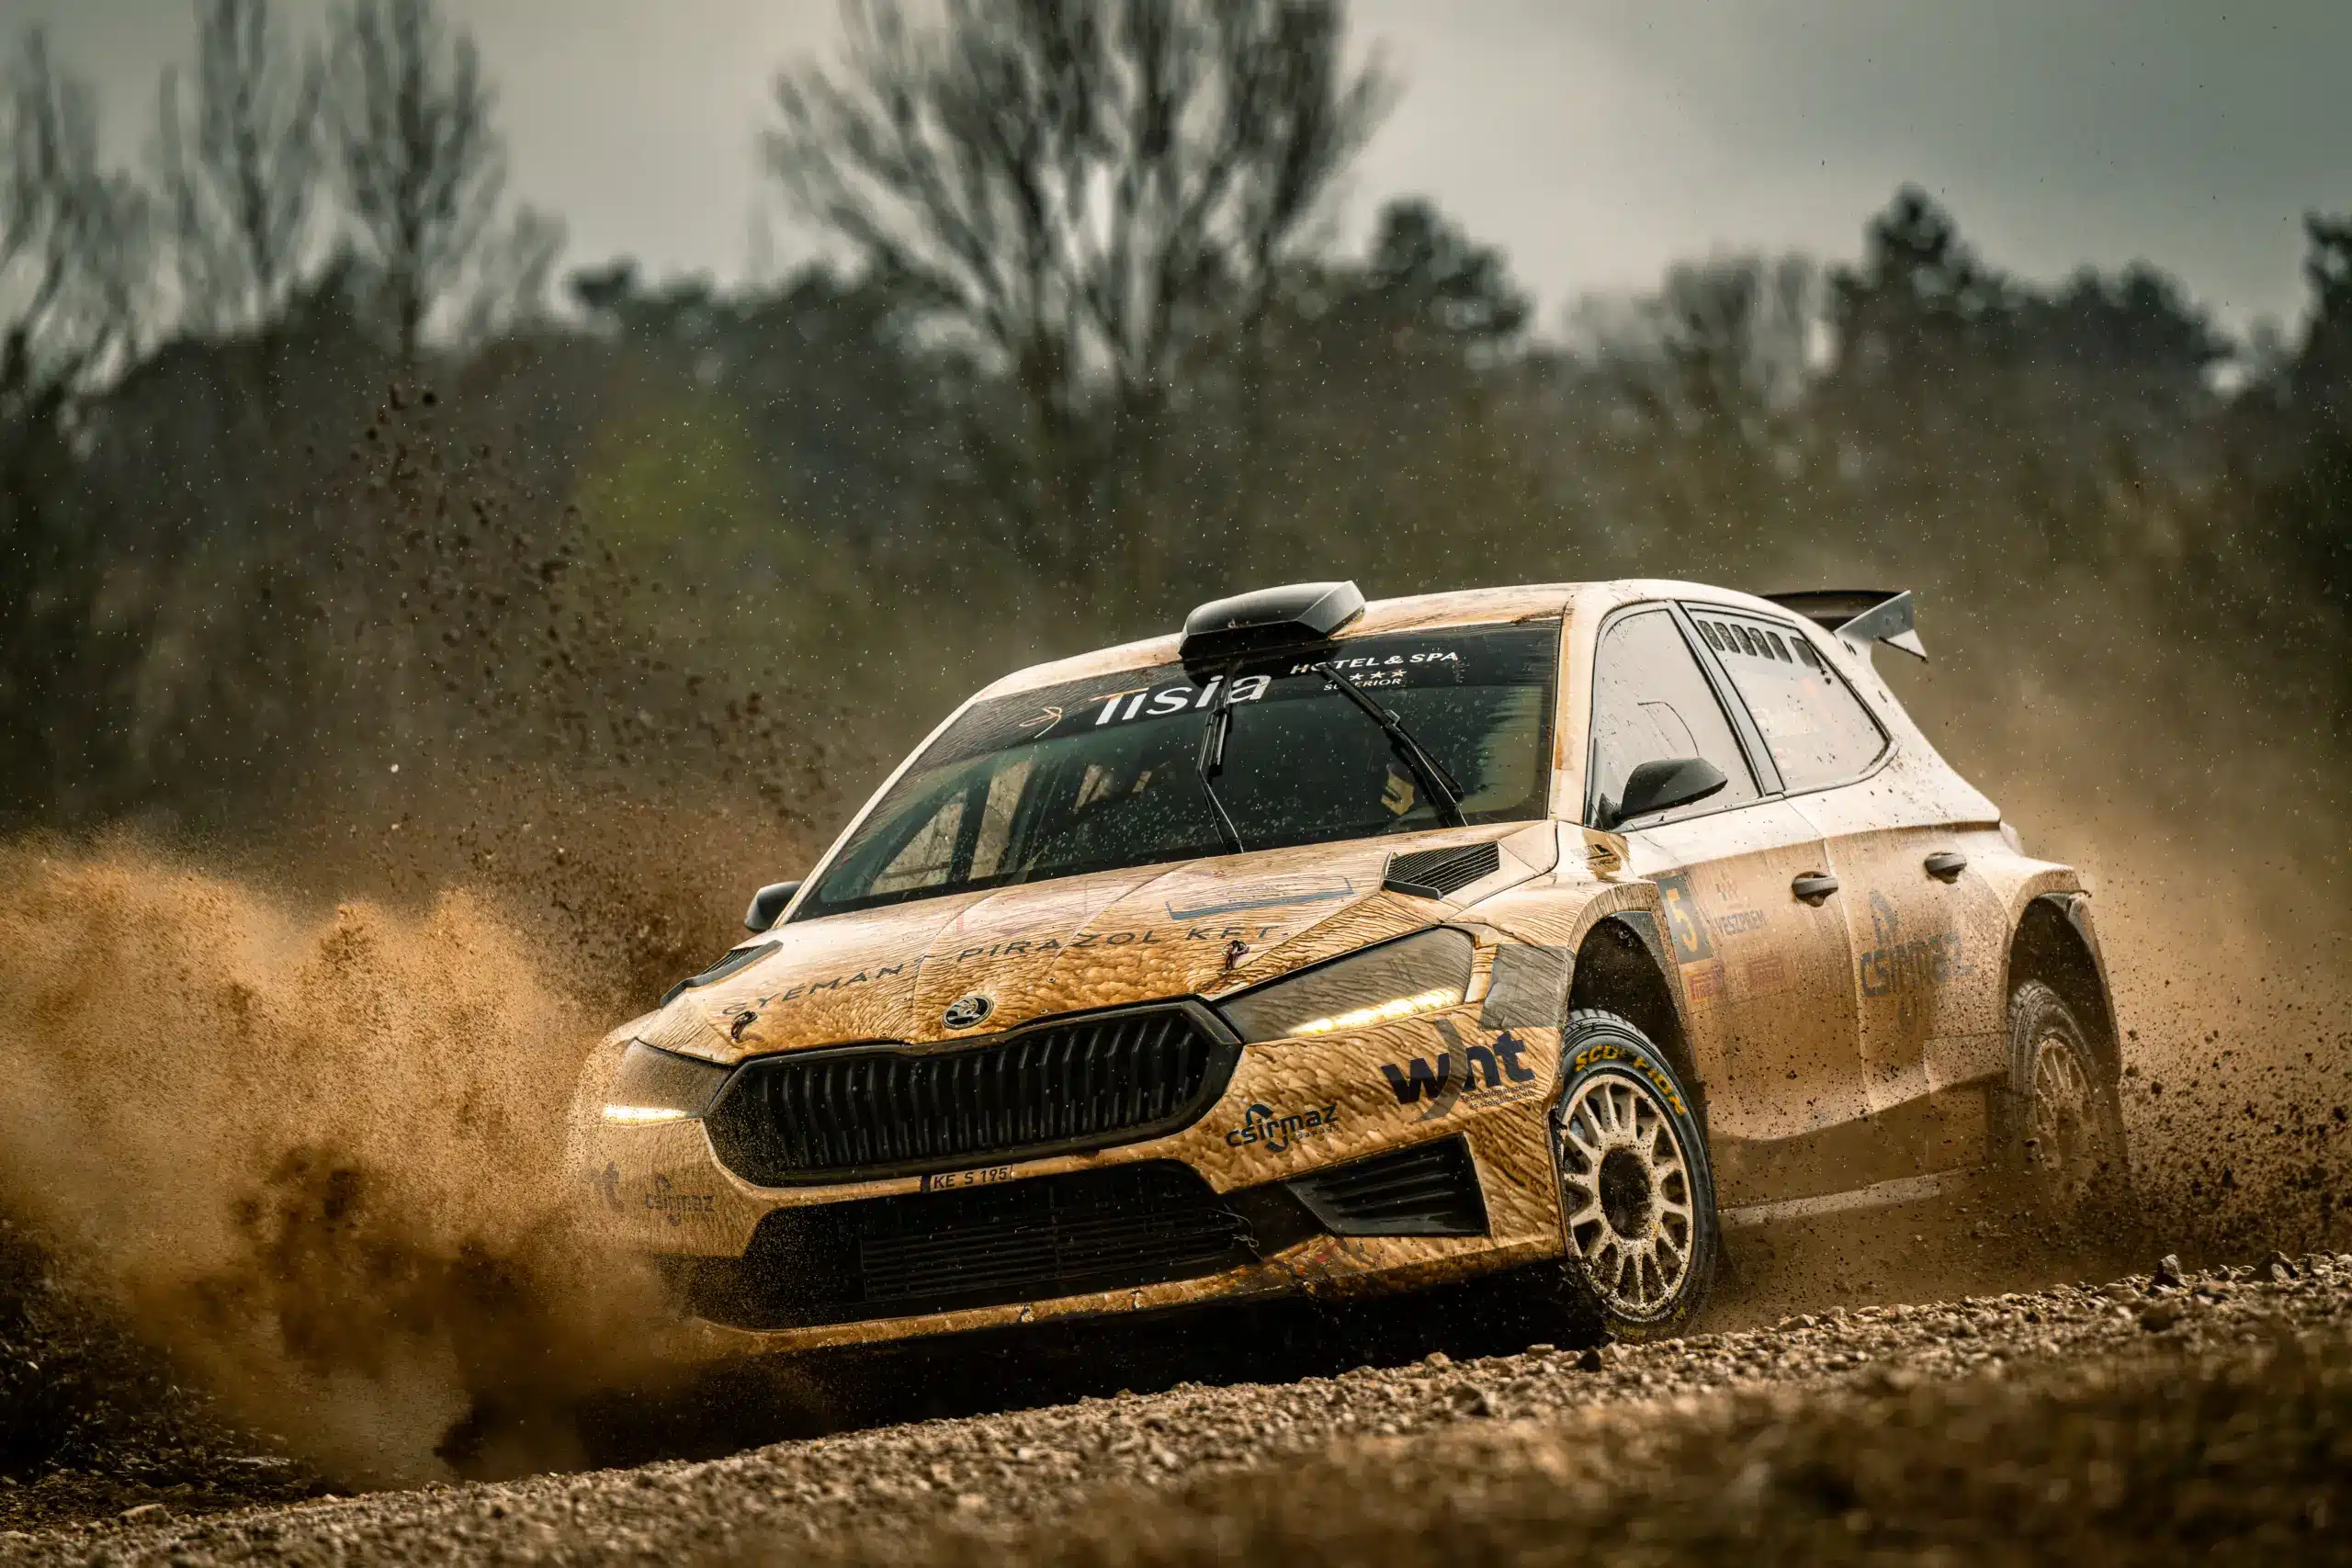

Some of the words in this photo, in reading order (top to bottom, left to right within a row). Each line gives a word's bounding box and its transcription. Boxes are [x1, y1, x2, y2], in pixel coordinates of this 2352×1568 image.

[1384, 655, 1405, 665] &
[1408, 651, 1459, 663] SPA
[1323, 678, 1401, 691] SUERIOR
[1666, 887, 1698, 953] 5
[956, 930, 1162, 964] PIRAZOL
[1380, 1030, 1537, 1105] wnt
[1226, 1101, 1340, 1151] csirmaz
[933, 1174, 956, 1190] KE
[964, 1171, 975, 1185] S
[980, 1168, 1008, 1183] 195
